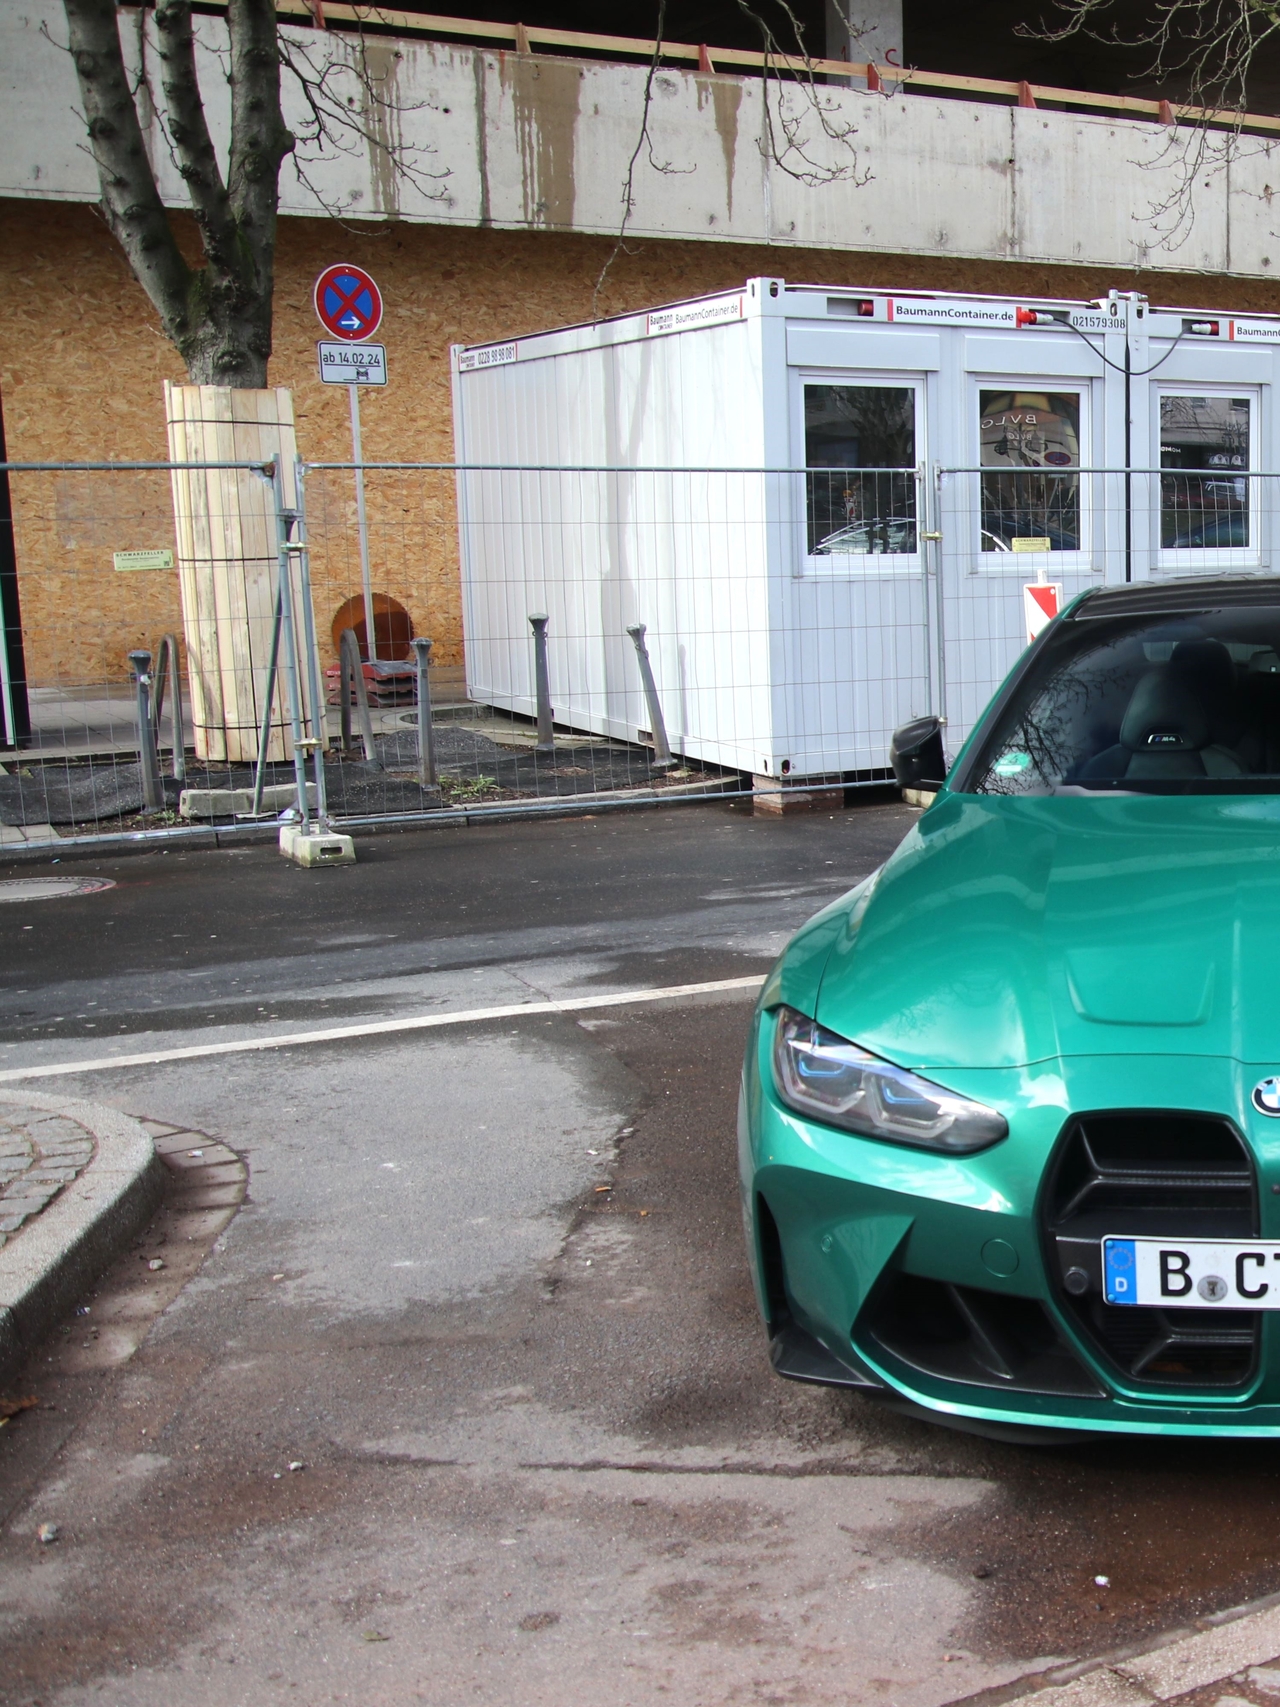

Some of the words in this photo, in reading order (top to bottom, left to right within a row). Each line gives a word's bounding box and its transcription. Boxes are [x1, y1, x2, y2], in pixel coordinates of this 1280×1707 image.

[650, 313, 673, 325] Baumann
[676, 302, 738, 324] BaumannContainer.de
[896, 305, 1014, 321] BaumannContainer.de
[1072, 316, 1126, 329] 021579308
[323, 351, 335, 363] ab
[338, 352, 380, 366] 14.02.24
[1159, 1250, 1193, 1296] B
[1115, 1277, 1127, 1292] D
